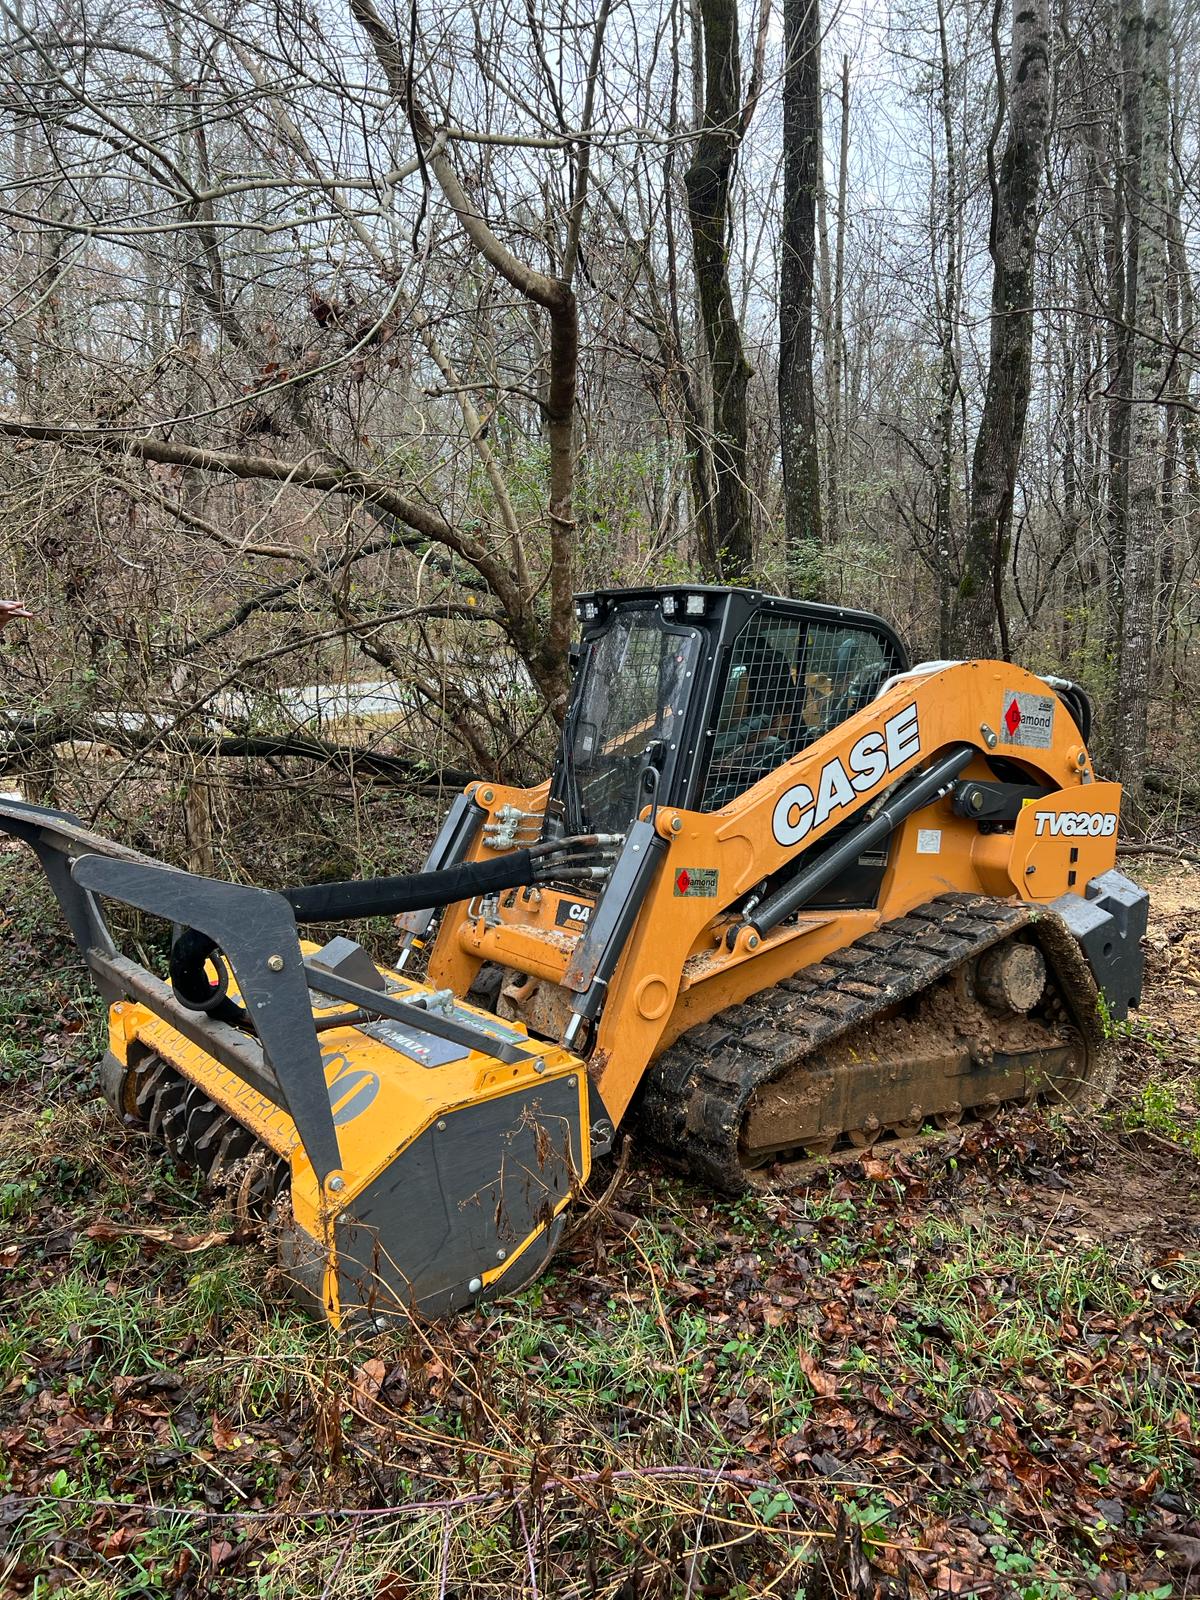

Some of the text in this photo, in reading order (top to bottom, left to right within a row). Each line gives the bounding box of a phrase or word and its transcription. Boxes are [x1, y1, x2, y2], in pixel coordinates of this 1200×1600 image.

[1011, 710, 1051, 728] Diamond
[772, 701, 921, 847] CASE
[1034, 811, 1117, 837] TV620B
[682, 876, 716, 887] Diamond
[569, 903, 590, 922] CA
[221, 1075, 282, 1121] EVERY
